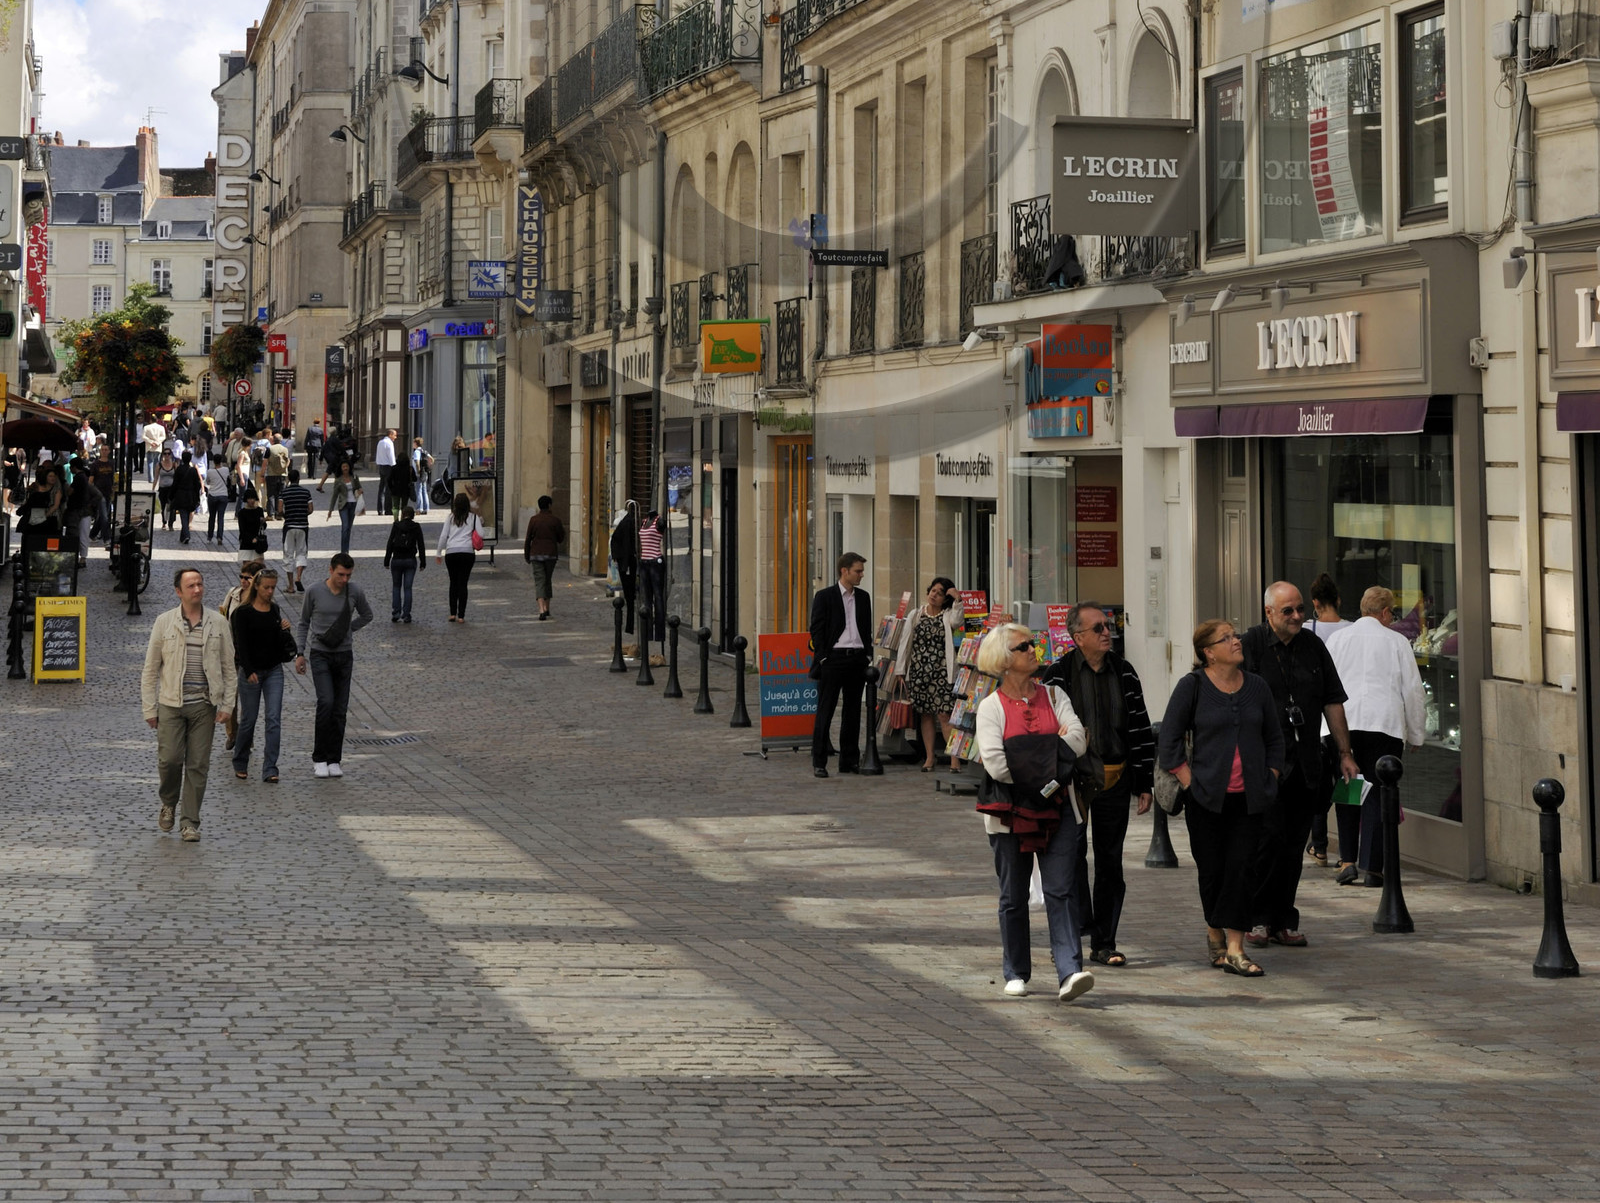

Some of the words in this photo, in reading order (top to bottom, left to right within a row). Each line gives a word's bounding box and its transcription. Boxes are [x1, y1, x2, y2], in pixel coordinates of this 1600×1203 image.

[1063, 156, 1178, 178] L'ECRIN
[1087, 190, 1154, 204] Joaillier
[213, 135, 252, 335] DECRE
[522, 199, 539, 299] CHAUSSEUR
[818, 253, 883, 264] Toutcomptefait
[445, 322, 484, 336] Crédit
[1257, 311, 1358, 370] L'ECRIN
[1045, 333, 1110, 356] Bookan
[1170, 341, 1209, 364] L'ECRIN
[1298, 406, 1334, 431] Joaillier
[762, 648, 814, 672] Booka
[765, 689, 800, 702] Jusqu'à
[803, 688, 818, 699] 60
[771, 703, 798, 713] moins
[801, 702, 818, 712] che
